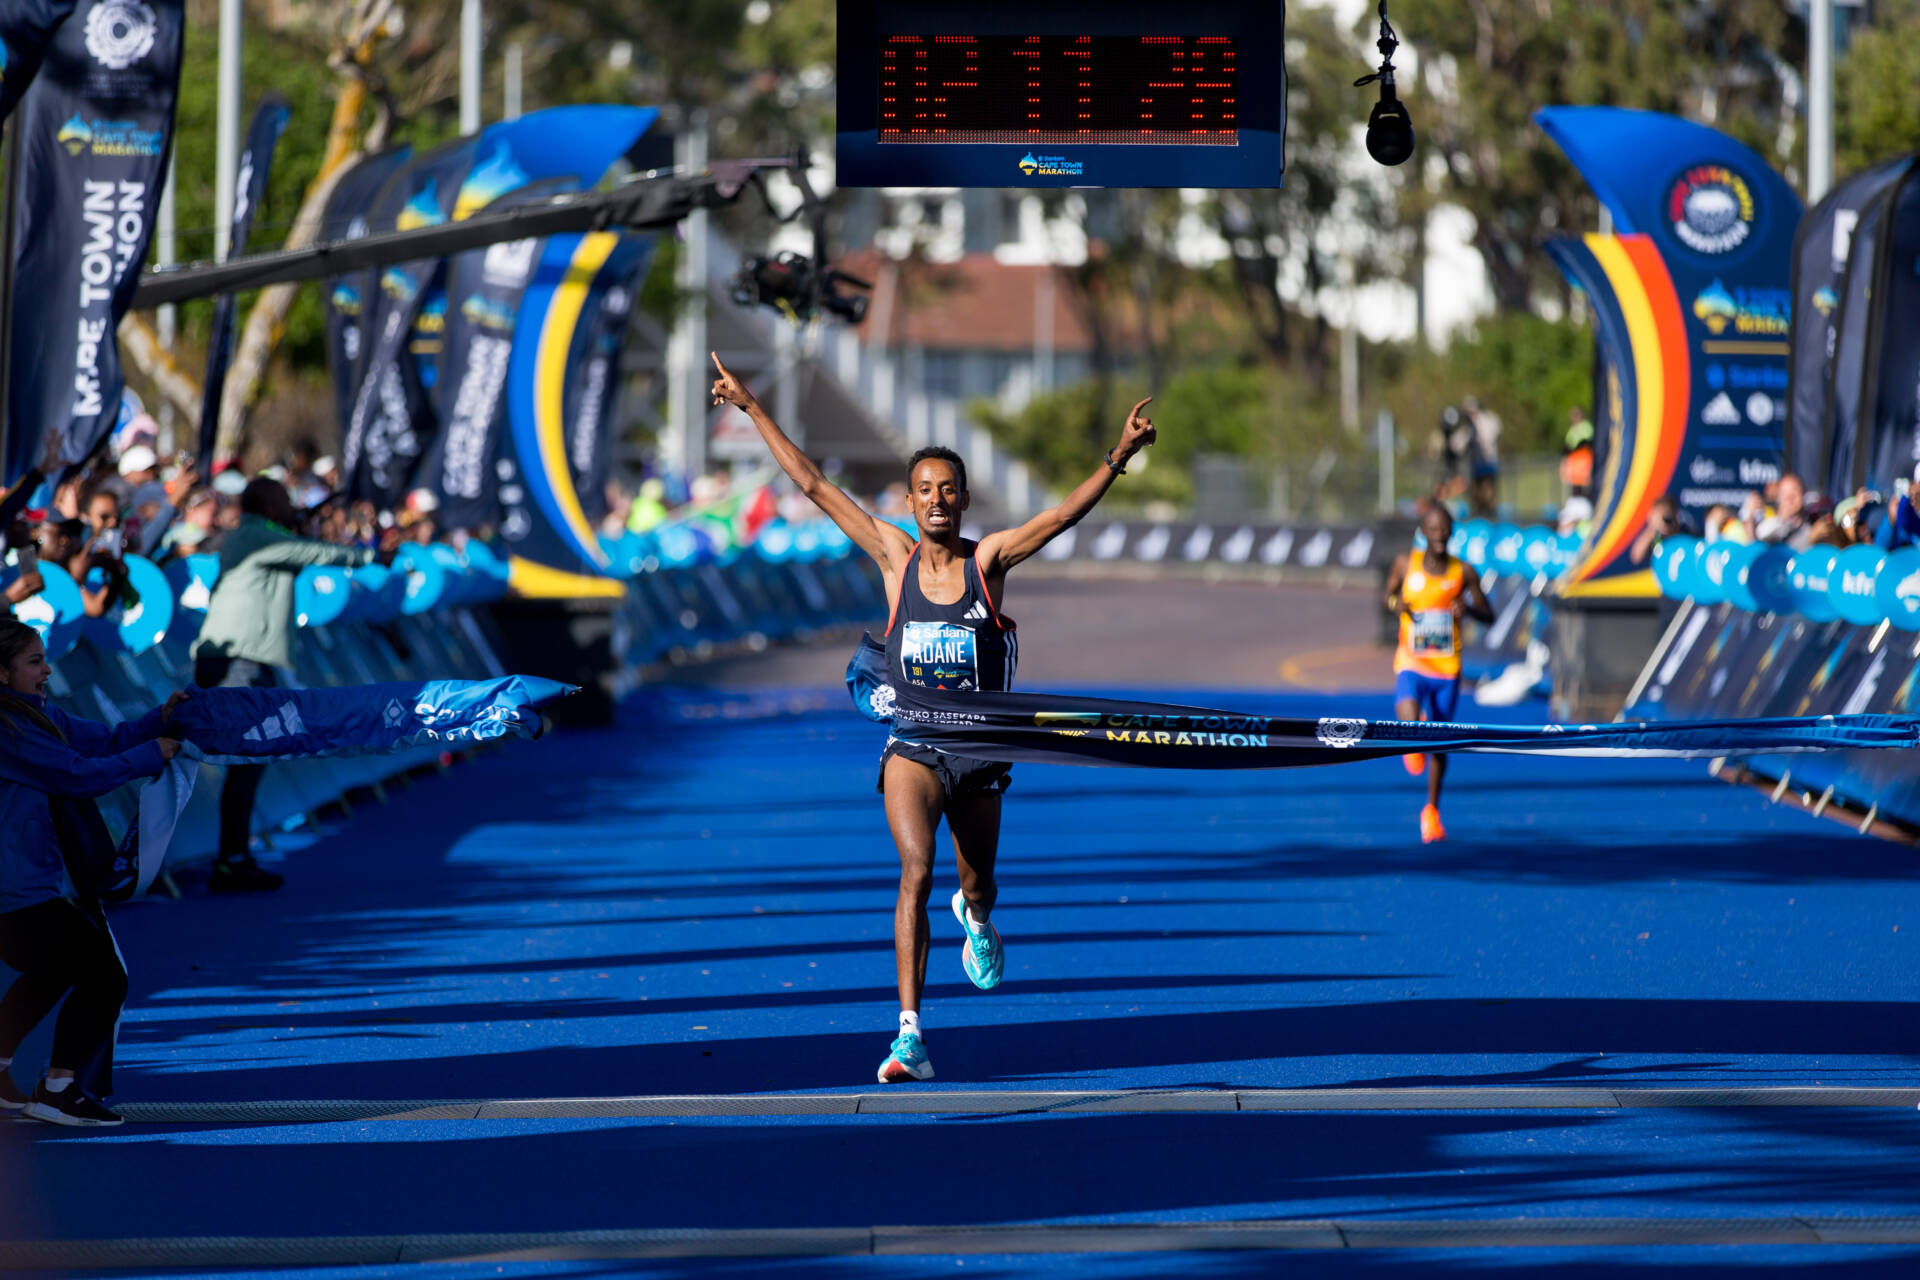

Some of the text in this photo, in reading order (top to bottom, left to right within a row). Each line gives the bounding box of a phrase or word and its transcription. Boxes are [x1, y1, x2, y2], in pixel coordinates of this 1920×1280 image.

[883, 34, 1236, 136] 02 11 28
[80, 179, 115, 308] TOWN
[912, 641, 967, 664] ADANE
[912, 679, 926, 688] ASA
[1107, 713, 1272, 731] CAPE TOWN
[1106, 730, 1268, 747] MARATHON
